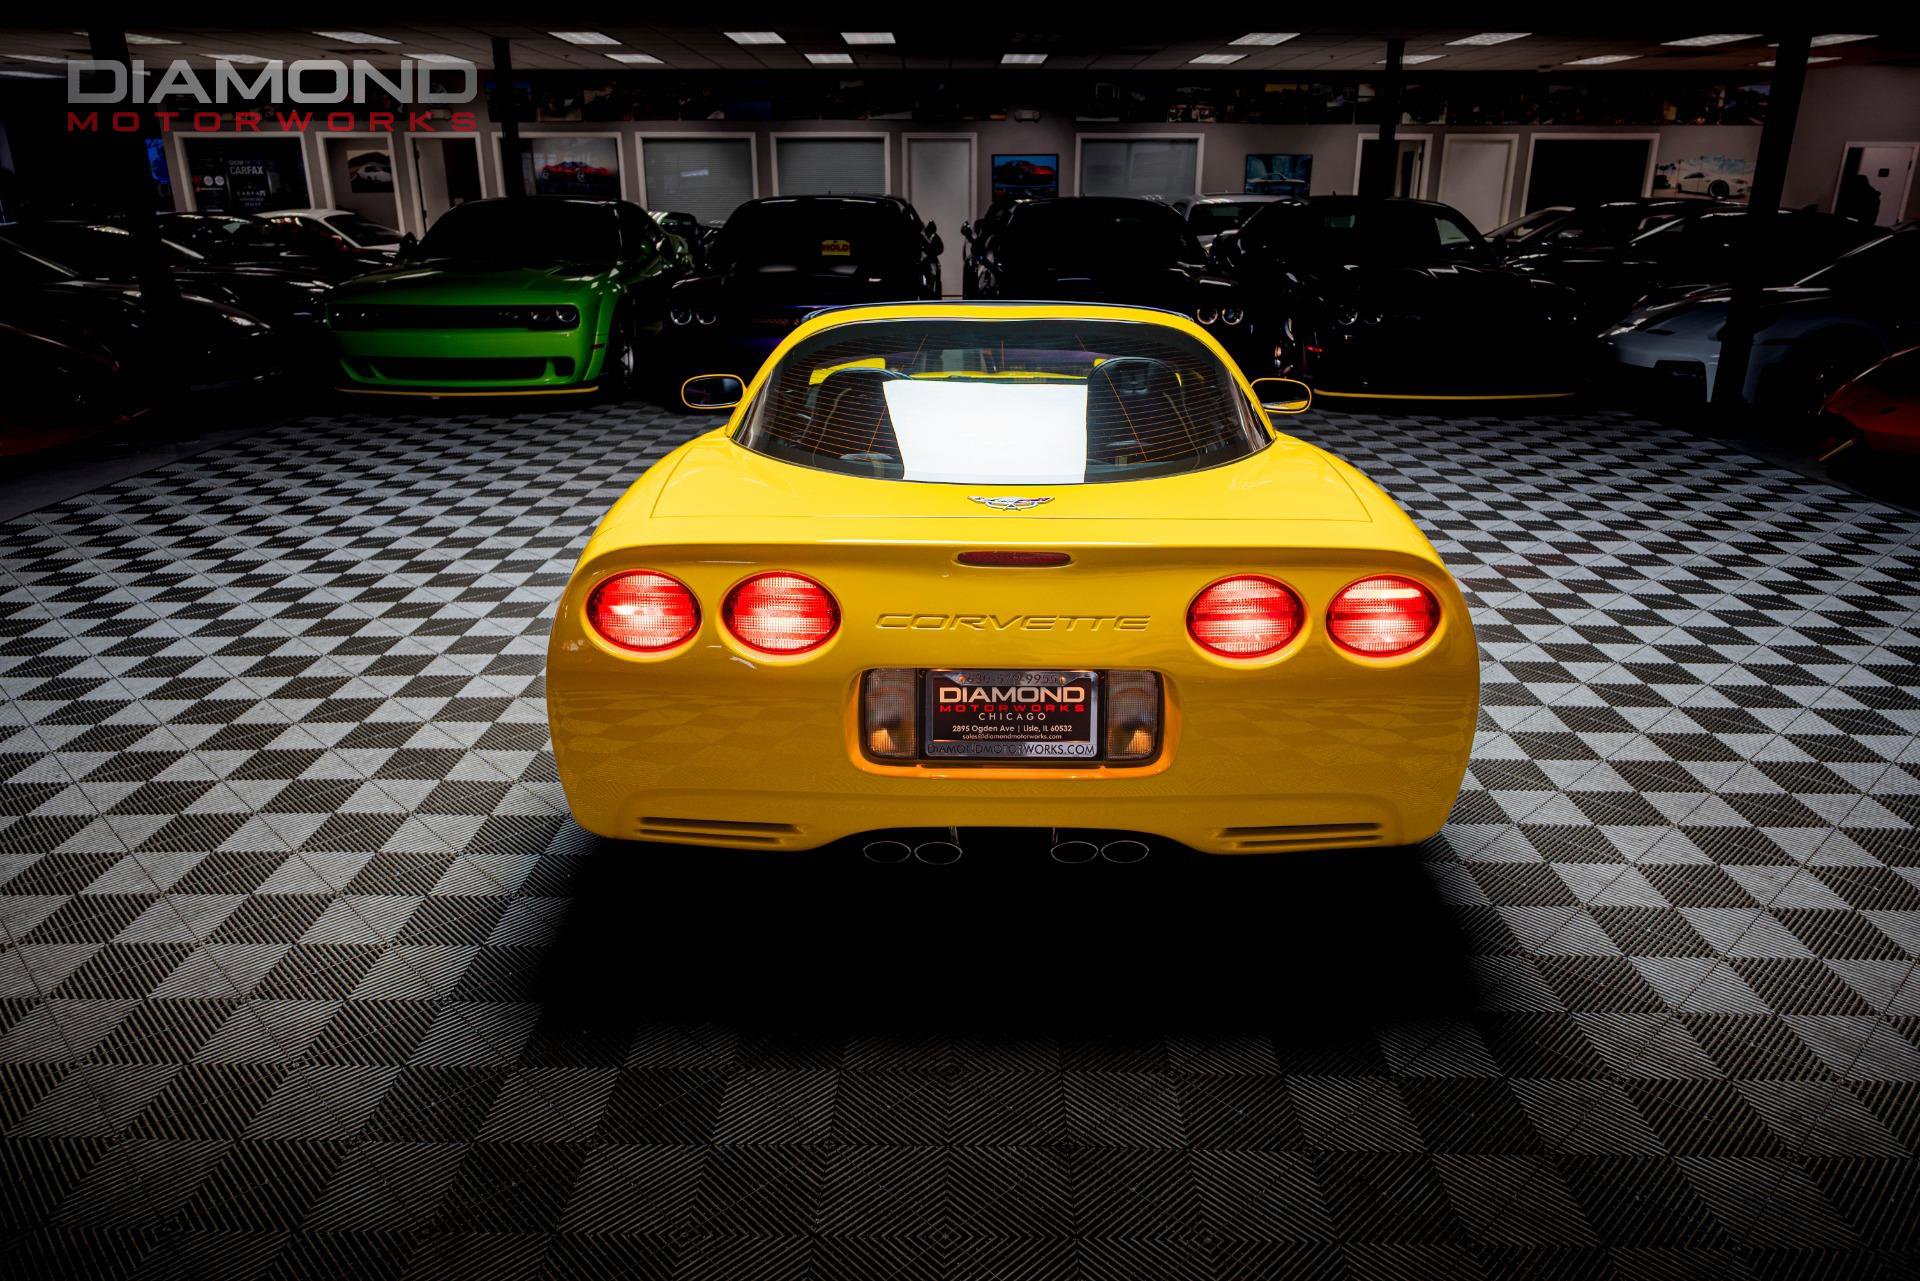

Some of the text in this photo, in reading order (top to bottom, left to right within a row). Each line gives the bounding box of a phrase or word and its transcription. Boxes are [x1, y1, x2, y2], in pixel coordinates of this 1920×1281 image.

[230, 166, 264, 175] CARFAX
[822, 244, 849, 252] HOLD
[876, 613, 1151, 632] CORVETTE
[939, 687, 1085, 703] DIAMOND
[939, 704, 1085, 713] MOTORWORKS
[978, 712, 1046, 721] CHICAGO
[971, 725, 998, 733] Ogden
[928, 744, 1095, 754] DIAMONDMOTORWORKS.COM
